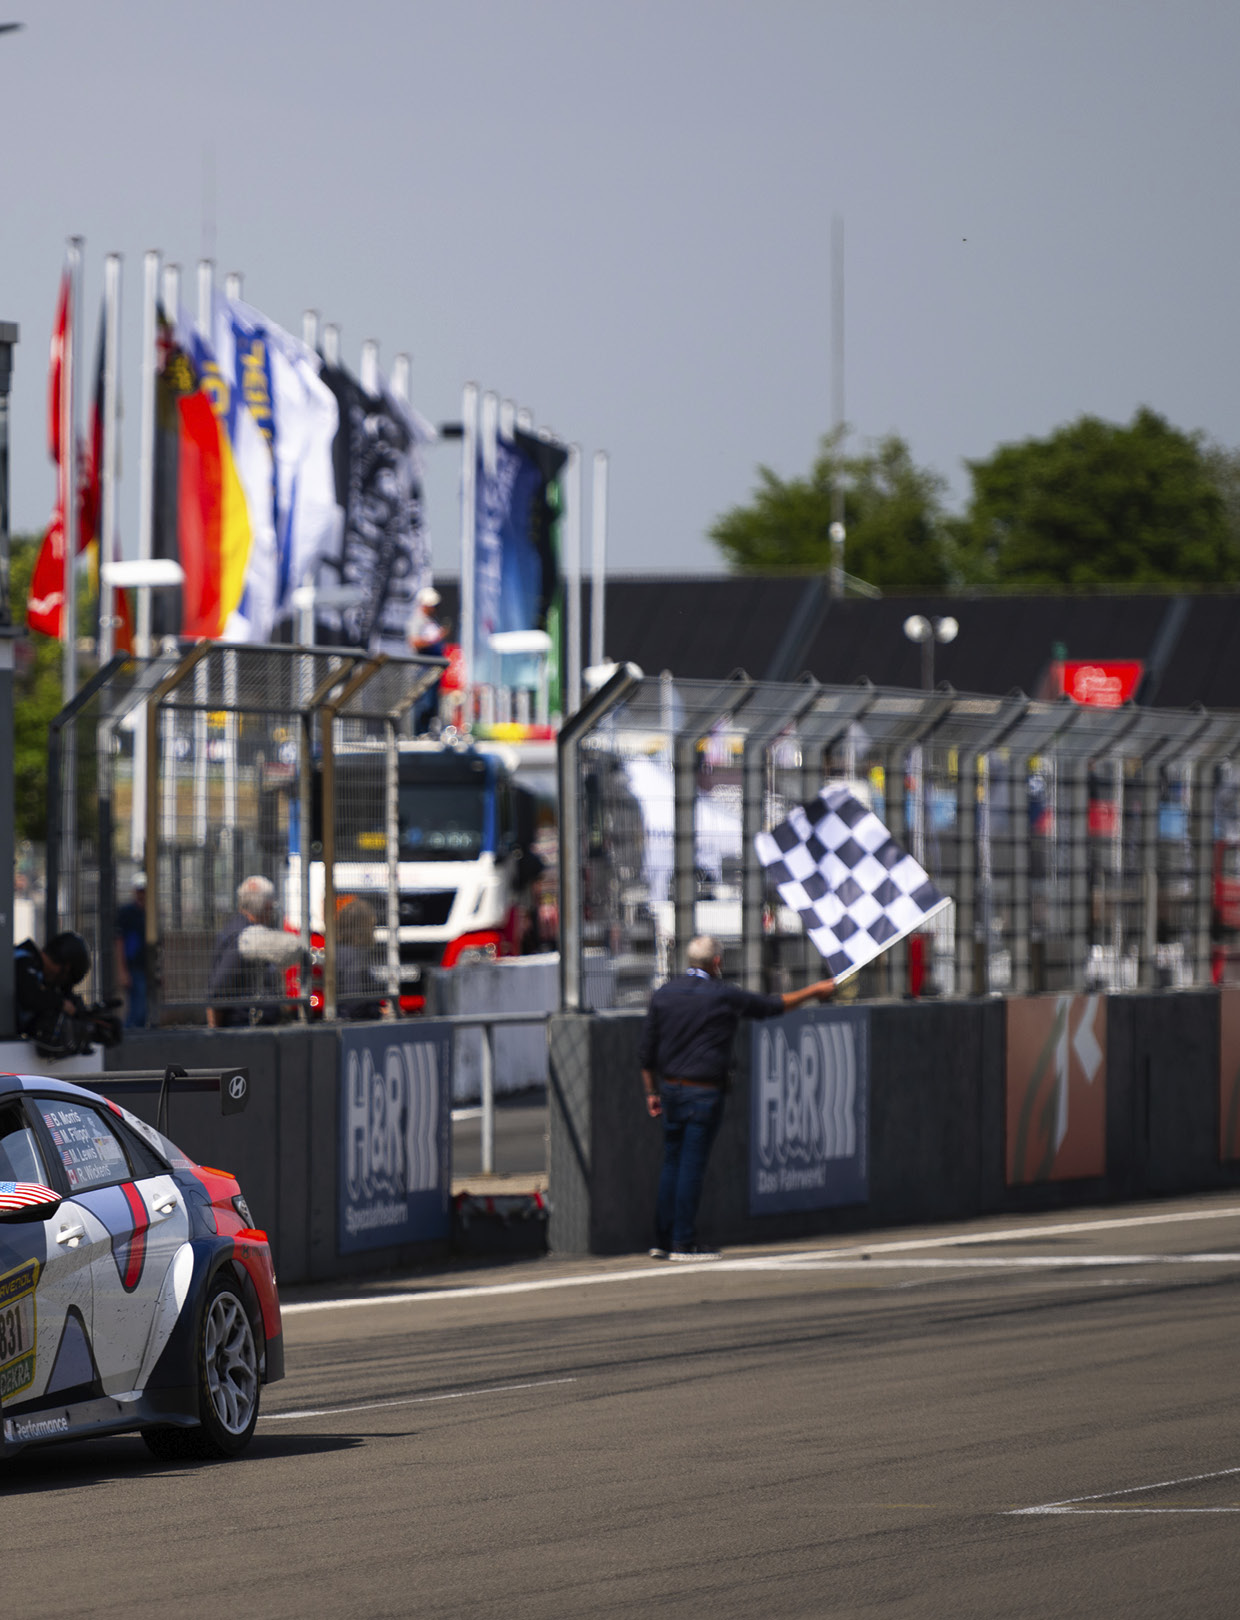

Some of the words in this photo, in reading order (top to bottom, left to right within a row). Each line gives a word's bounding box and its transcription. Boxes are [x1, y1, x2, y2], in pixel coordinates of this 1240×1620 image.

[58, 1109, 82, 1125] Morris
[77, 1145, 98, 1161] Lewis
[0, 1362, 31, 1396] DEKRA
[17, 1416, 69, 1438] Performance
